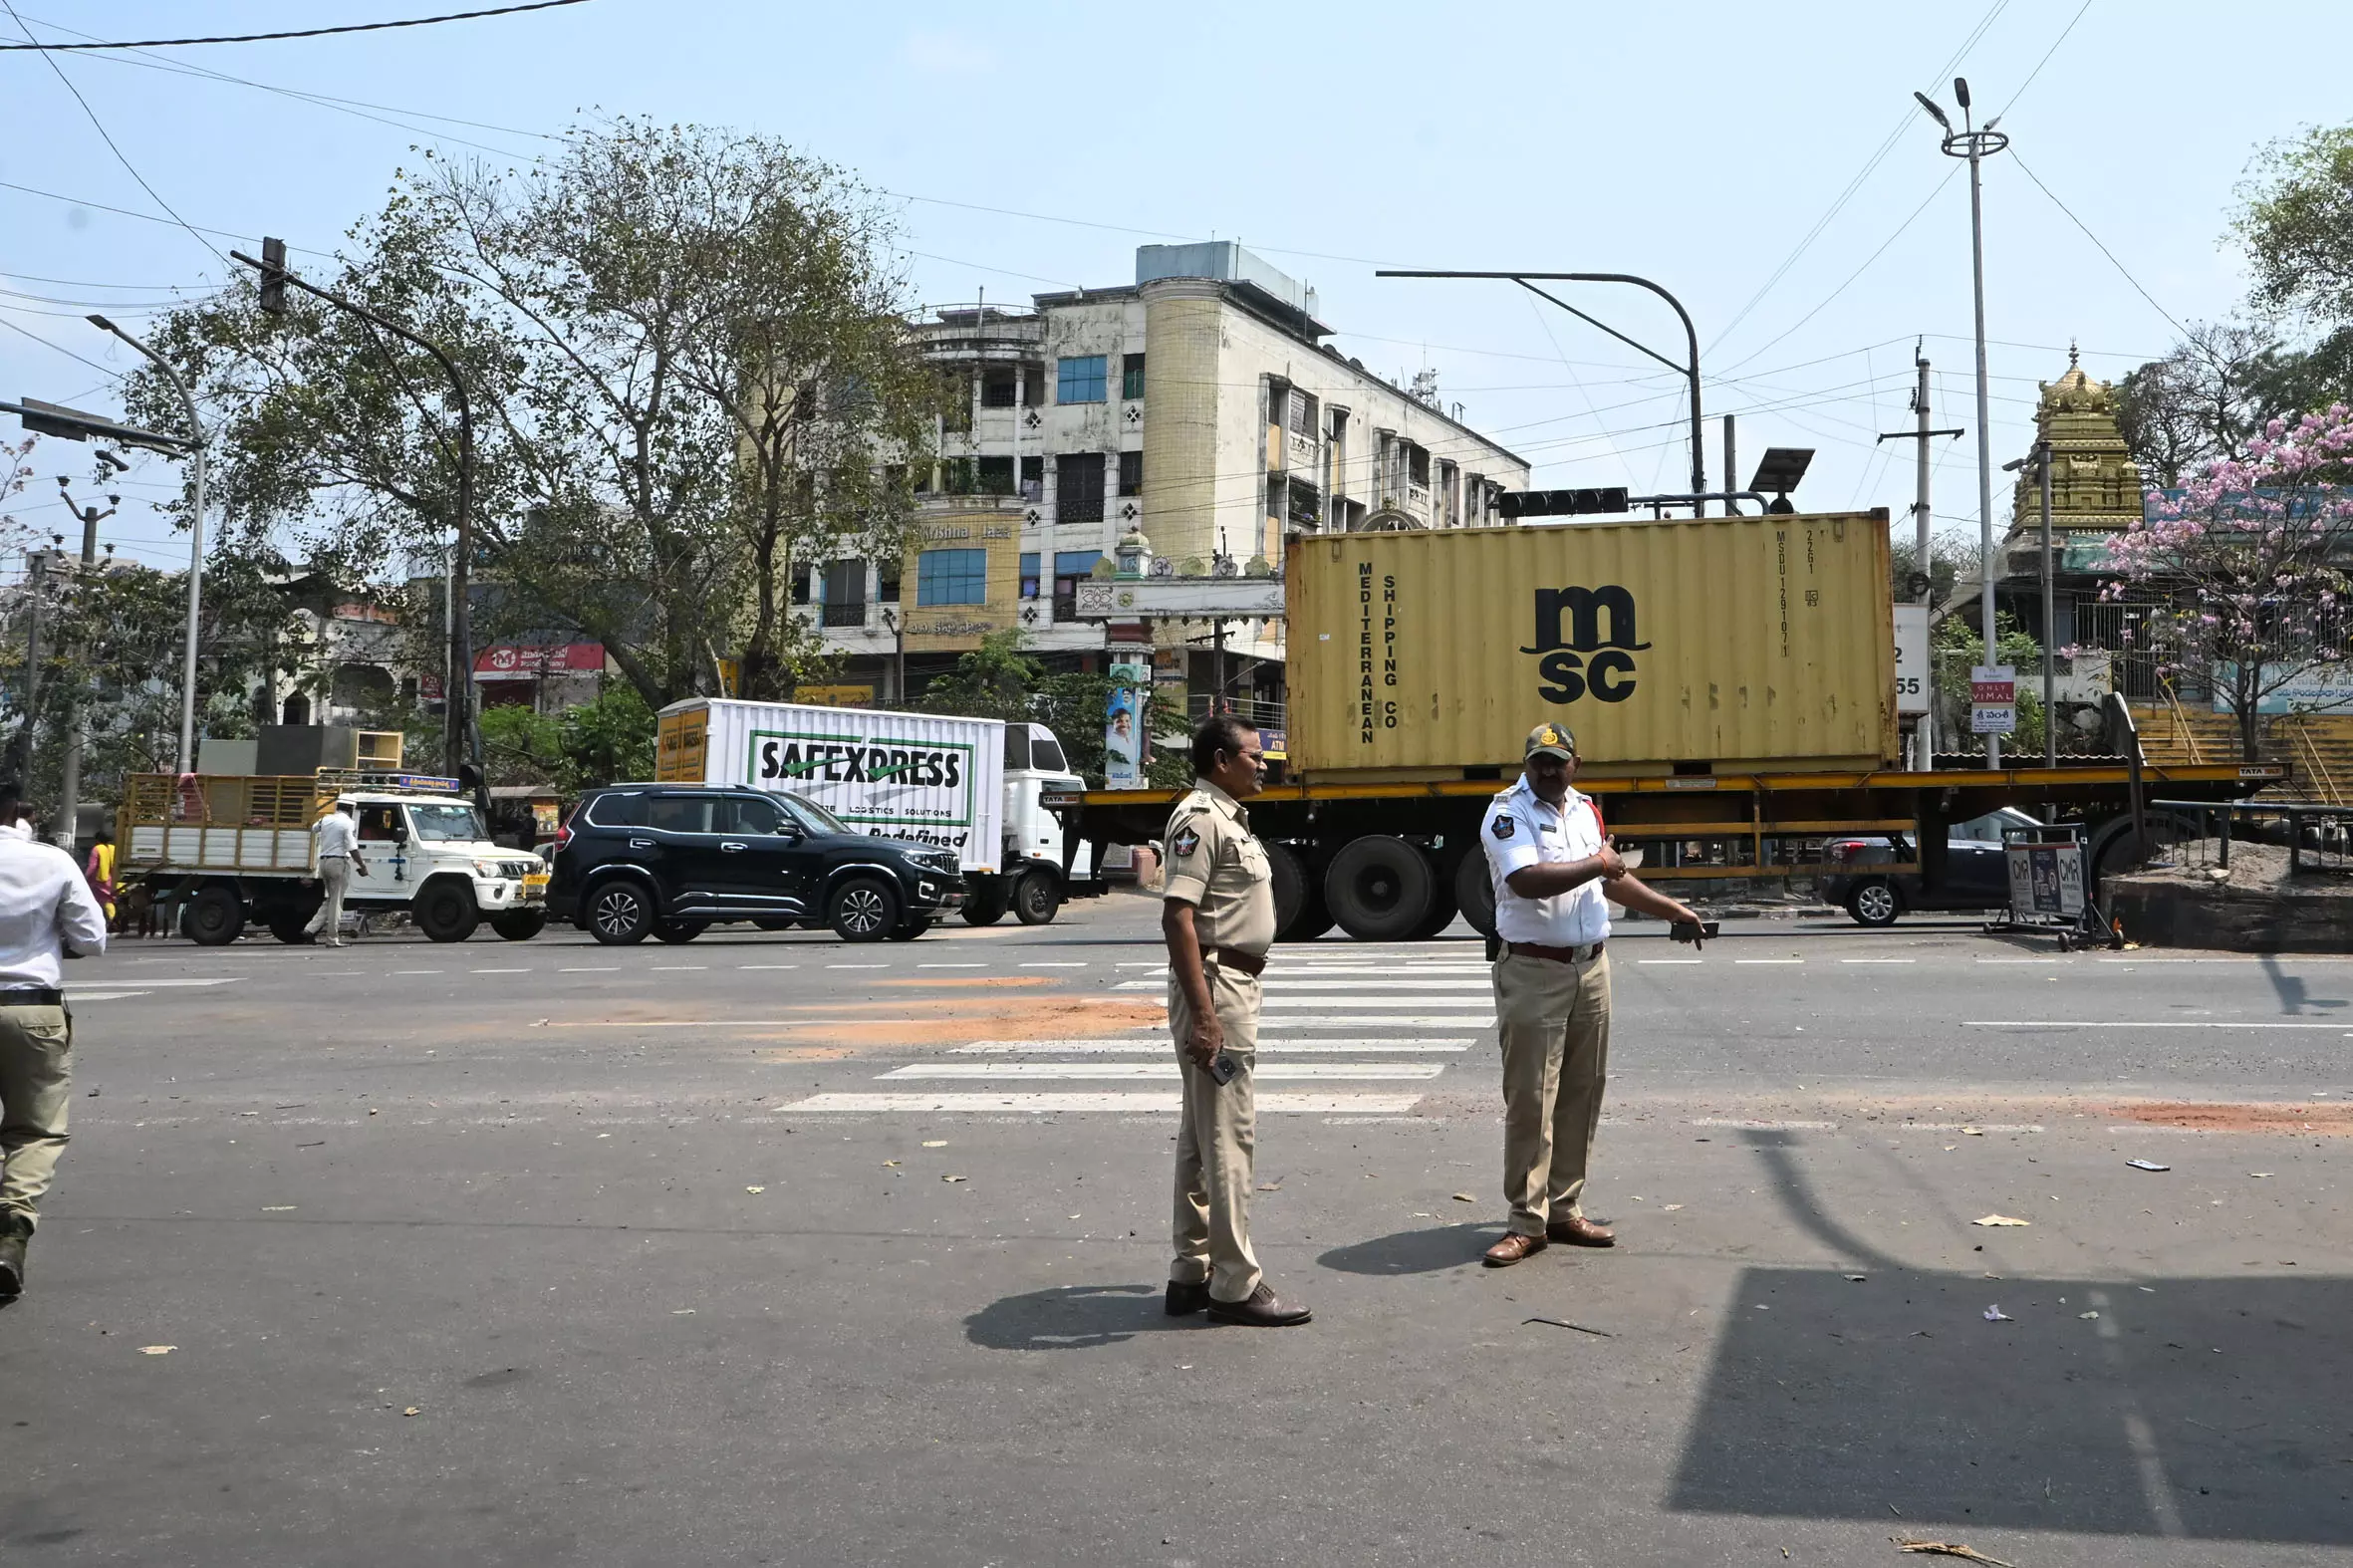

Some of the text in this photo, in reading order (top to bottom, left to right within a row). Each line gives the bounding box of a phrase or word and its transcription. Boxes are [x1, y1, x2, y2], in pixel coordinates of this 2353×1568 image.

[1359, 562, 1373, 744] MEDITERRANEAN
[1384, 575, 1397, 729] SHIPPING CO
[761, 741, 960, 788] SAFEXPRESS
[1270, 740, 1285, 751] ATM
[849, 806, 895, 815] LOGSTICS
